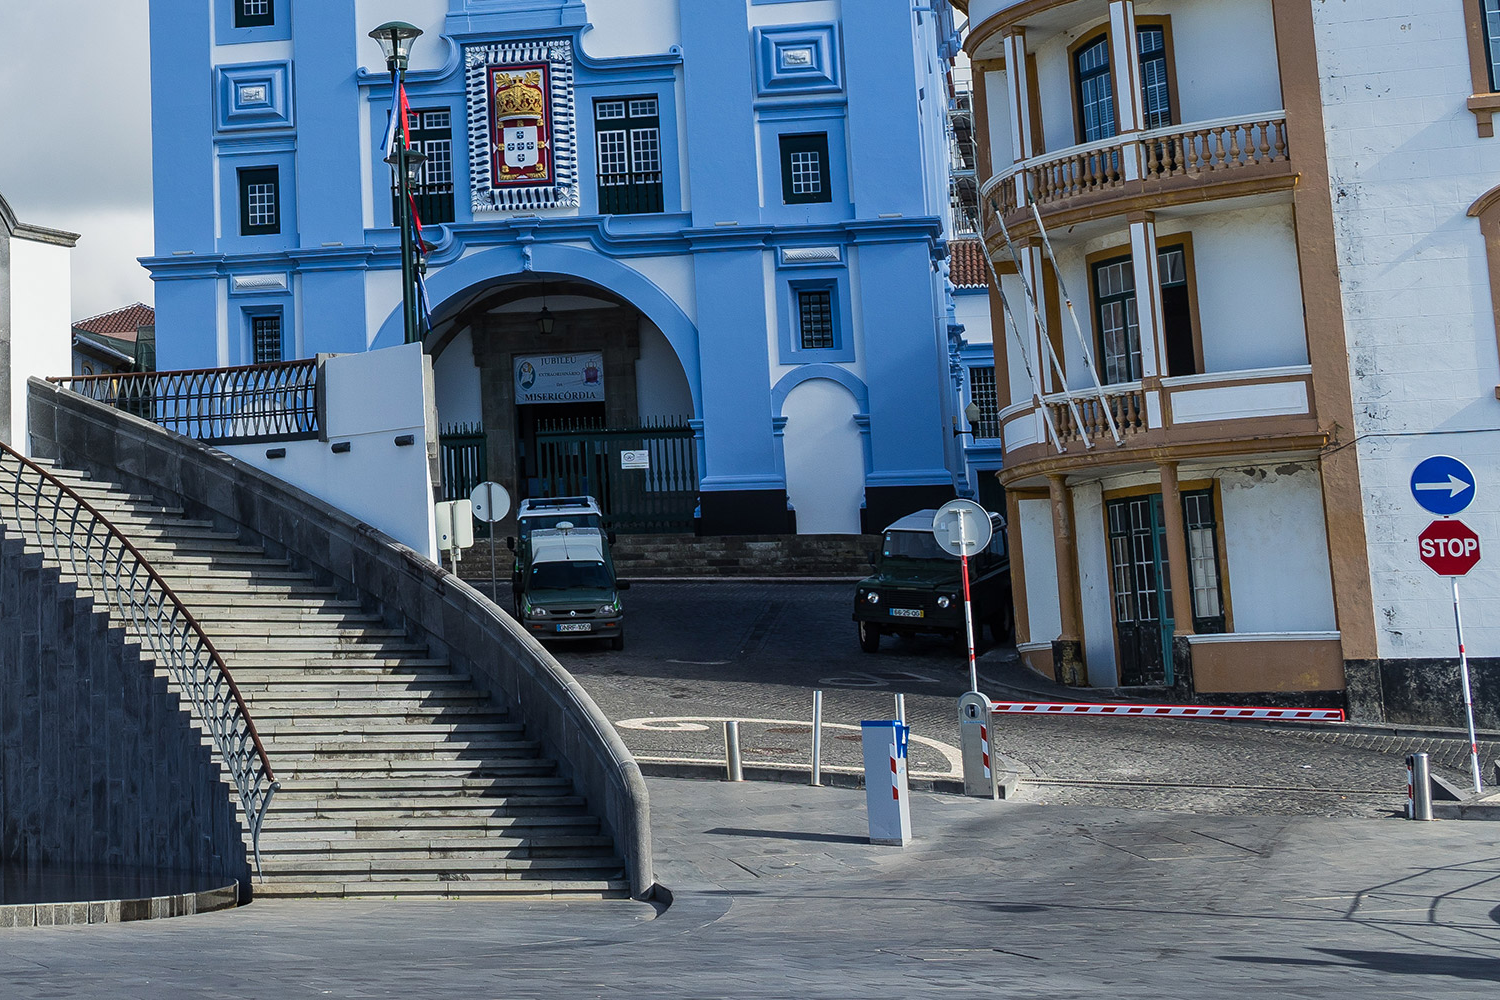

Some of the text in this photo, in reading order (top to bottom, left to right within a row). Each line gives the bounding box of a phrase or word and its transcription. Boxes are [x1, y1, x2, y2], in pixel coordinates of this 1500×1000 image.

[541, 356, 577, 366] JUBILEU
[525, 391, 596, 401] MISERICÓRDIA
[1421, 538, 1477, 558] STOP
